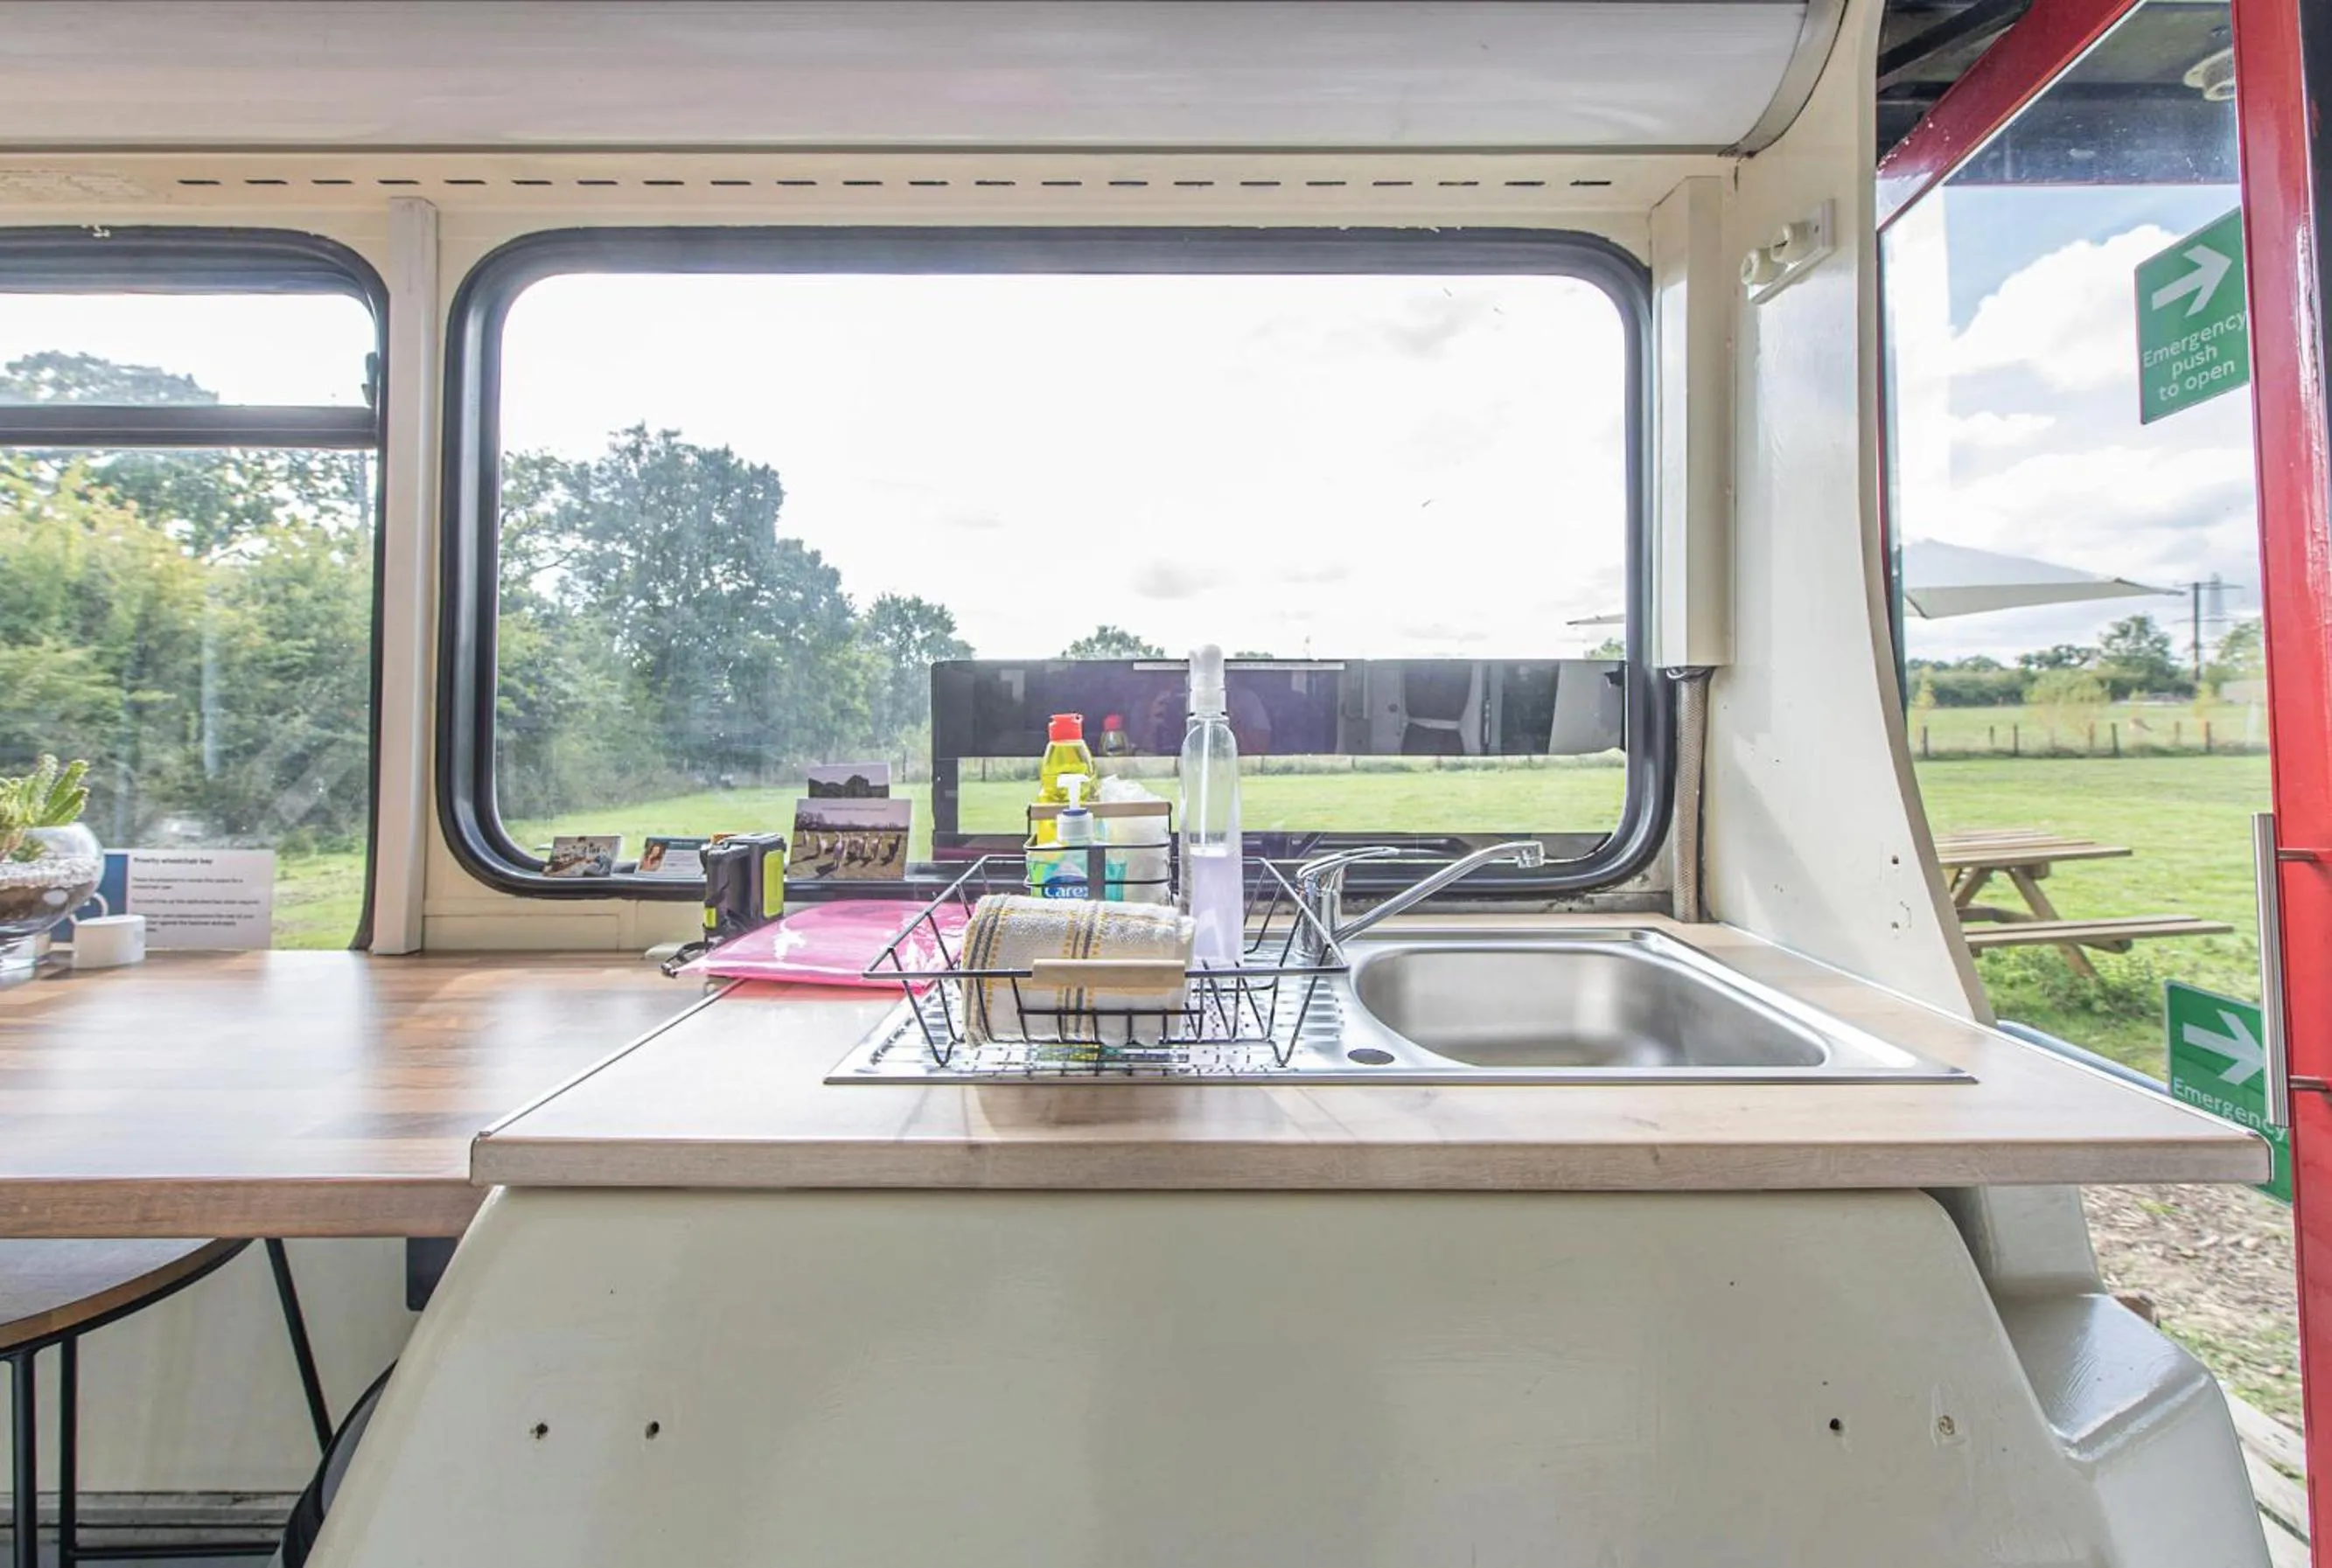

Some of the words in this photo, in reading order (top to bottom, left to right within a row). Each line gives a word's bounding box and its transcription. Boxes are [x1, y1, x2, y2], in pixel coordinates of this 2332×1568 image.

[2142, 310, 2246, 368] Emergency
[2172, 344, 2217, 380] push
[2160, 383, 2179, 401] to
[2185, 359, 2235, 390] open
[2173, 1077, 2286, 1141] Emergency
